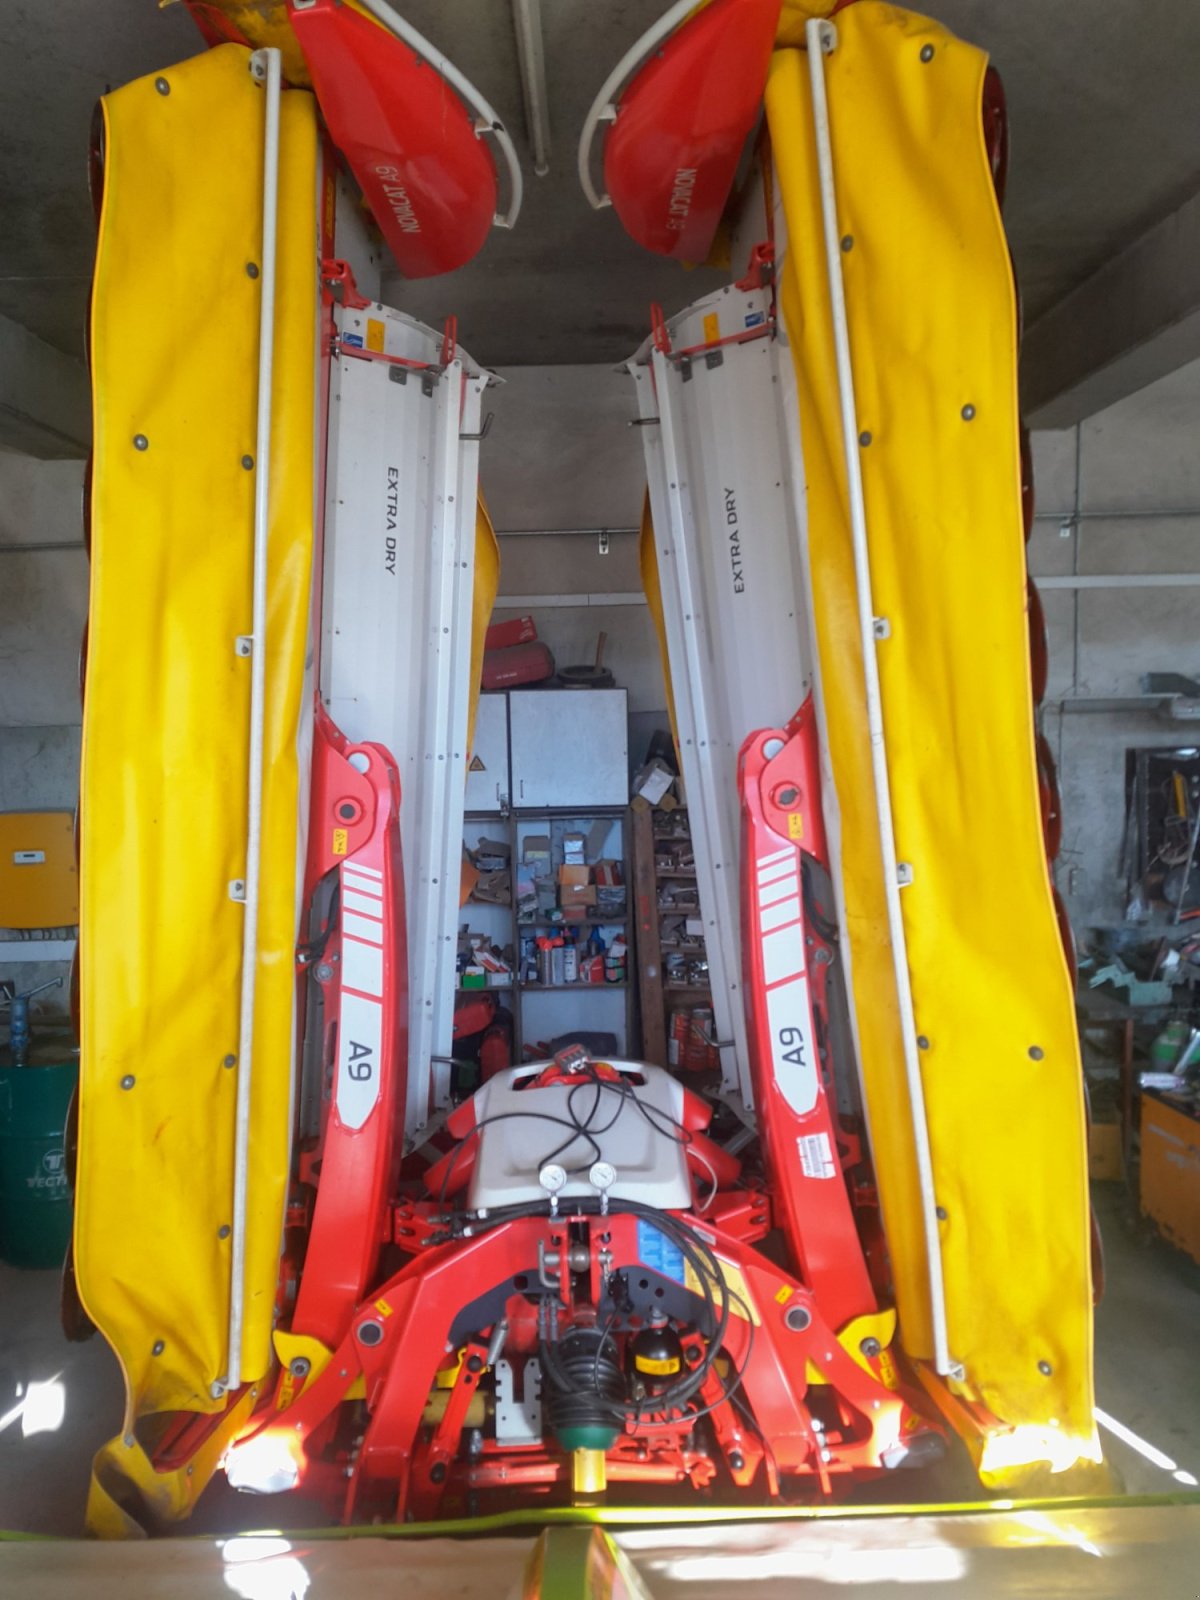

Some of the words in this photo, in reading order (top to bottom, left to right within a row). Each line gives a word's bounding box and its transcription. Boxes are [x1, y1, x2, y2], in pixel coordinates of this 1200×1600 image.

[375, 166, 400, 182] A9
[669, 168, 698, 217] NOVACAT
[382, 184, 422, 233] NOVACAT
[386, 466, 399, 530] EXTRA
[724, 487, 739, 525] DRY
[385, 537, 397, 576] DRY
[729, 529, 745, 594] EXTRA
[348, 1040, 373, 1082] A9
[779, 1026, 806, 1067] A9
